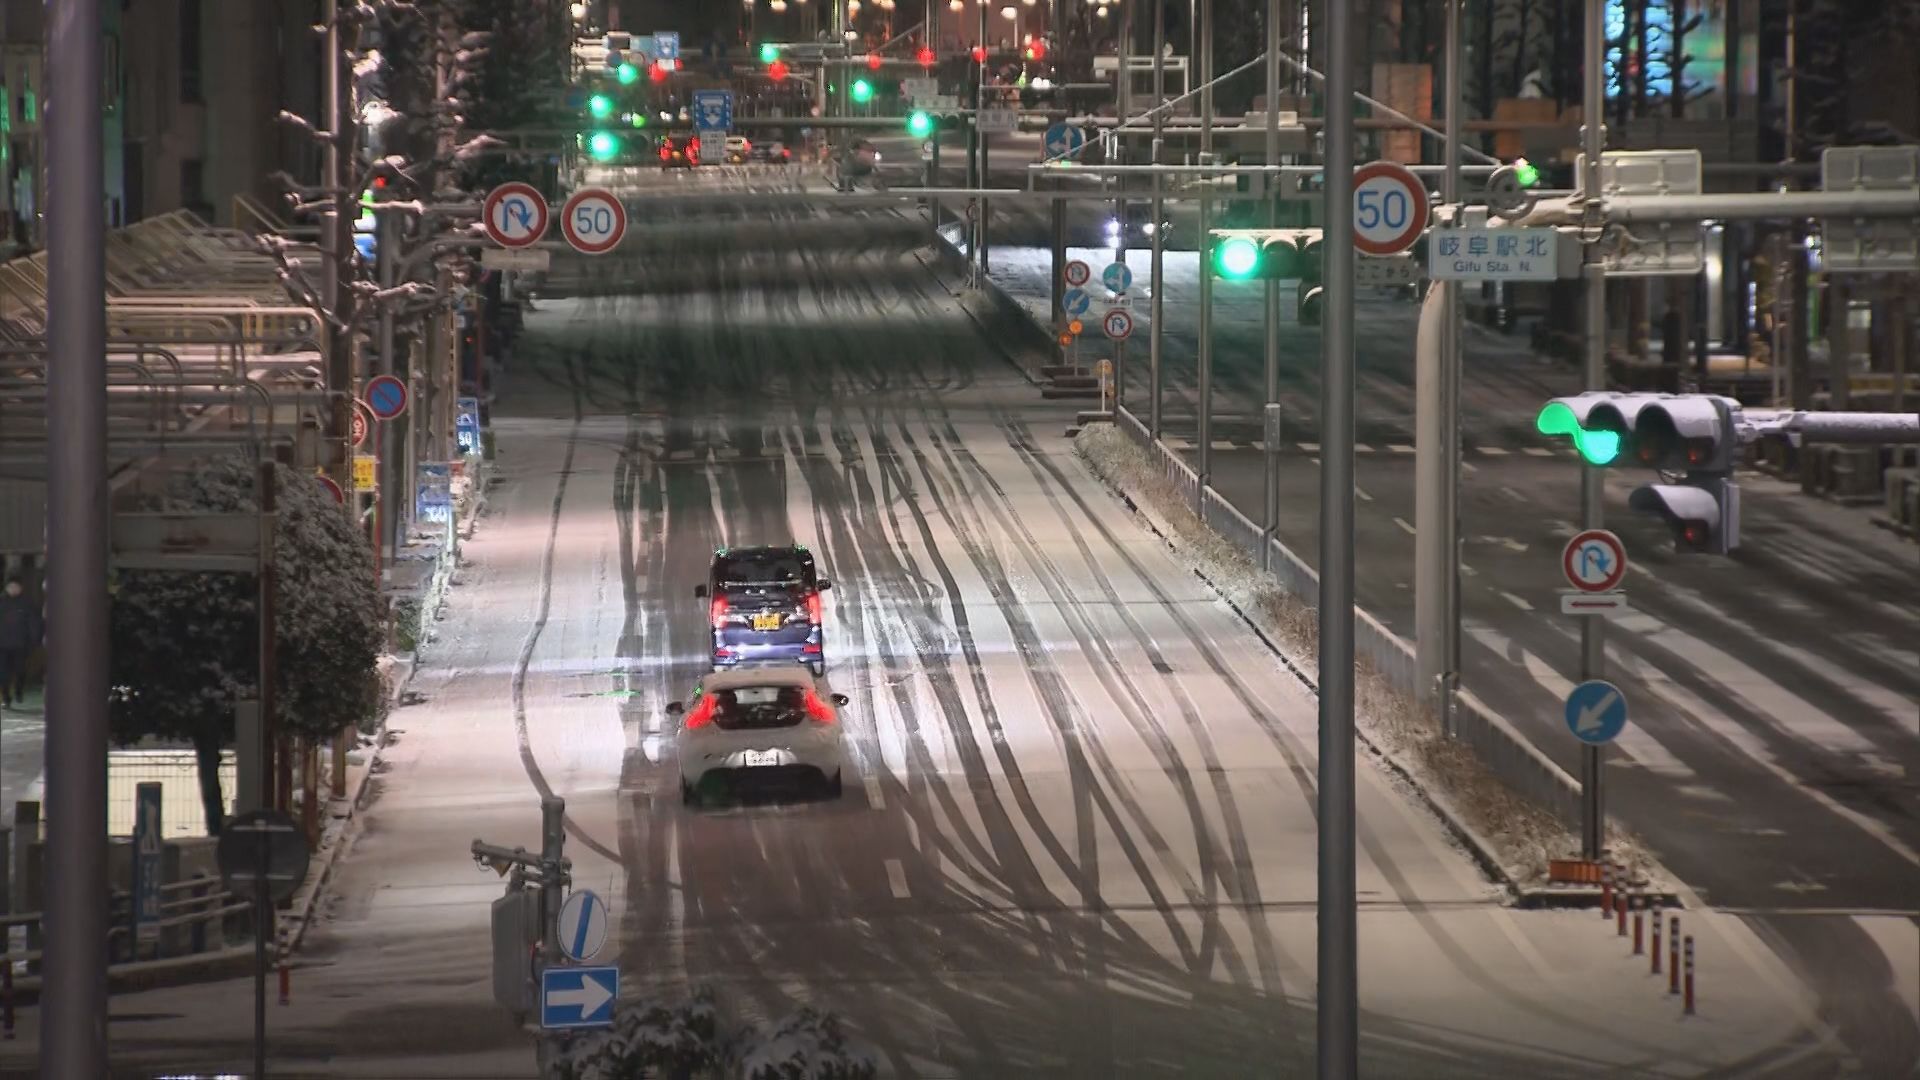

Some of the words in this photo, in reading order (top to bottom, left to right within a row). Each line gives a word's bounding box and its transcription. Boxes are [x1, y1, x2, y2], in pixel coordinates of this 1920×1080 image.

[577, 207, 611, 234] 50
[1358, 190, 1407, 229] 50
[1439, 235, 1547, 257] 岐阜駅北
[1453, 261, 1481, 272] Gifu
[1487, 261, 1511, 272] Sta.
